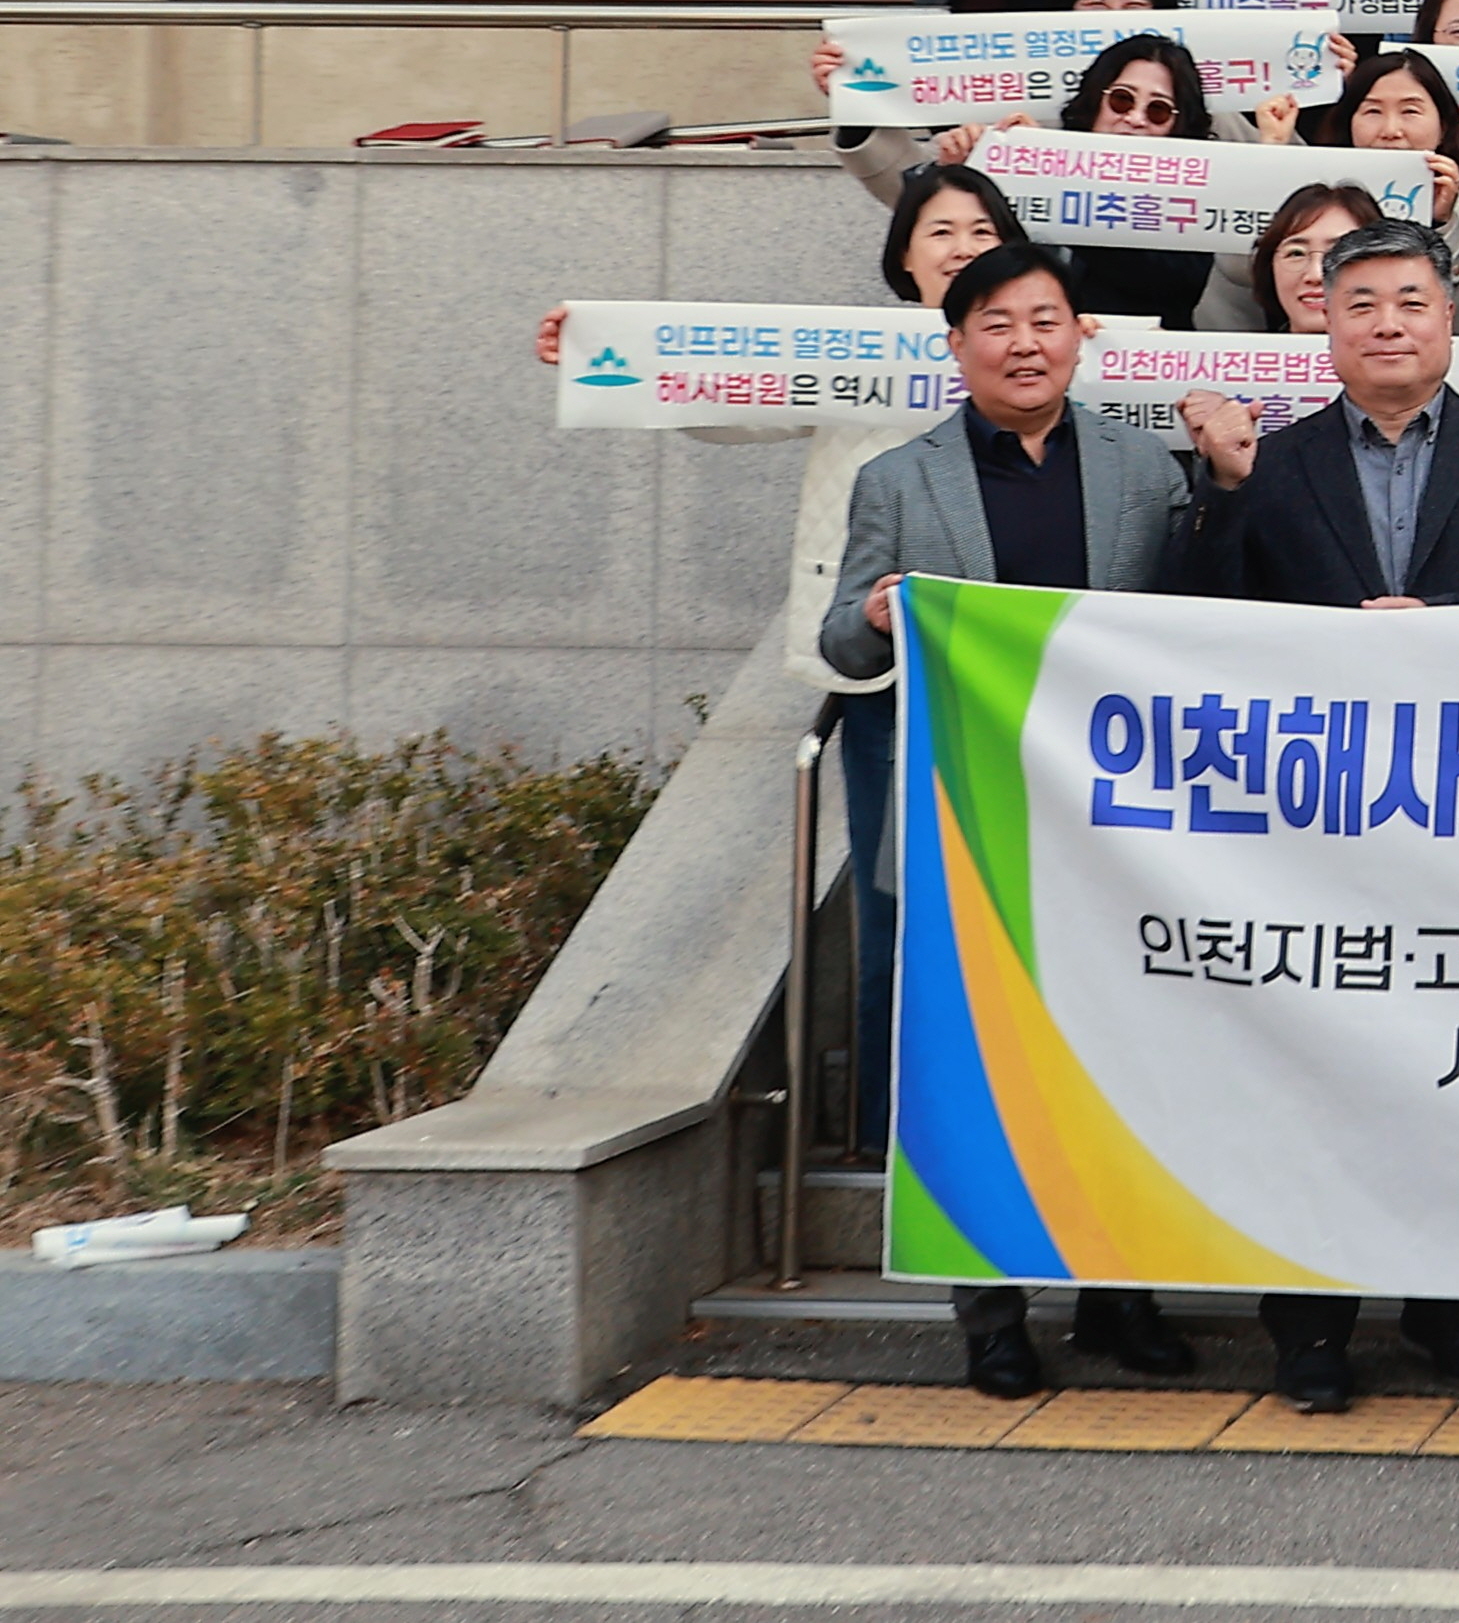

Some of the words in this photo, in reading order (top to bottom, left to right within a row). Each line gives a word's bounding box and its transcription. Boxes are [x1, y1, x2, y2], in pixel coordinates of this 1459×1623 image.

[907, 28, 1014, 63] 인프라도
[1024, 31, 1103, 59] 열정도
[911, 72, 1052, 104] 해사법원은
[986, 146, 1209, 186] 인천해사전문법원
[654, 325, 779, 359] 인프라도
[792, 325, 885, 360] 열정도
[656, 371, 819, 410] 해사법원은
[831, 375, 893, 408] 역시
[1100, 401, 1175, 430] 준비된
